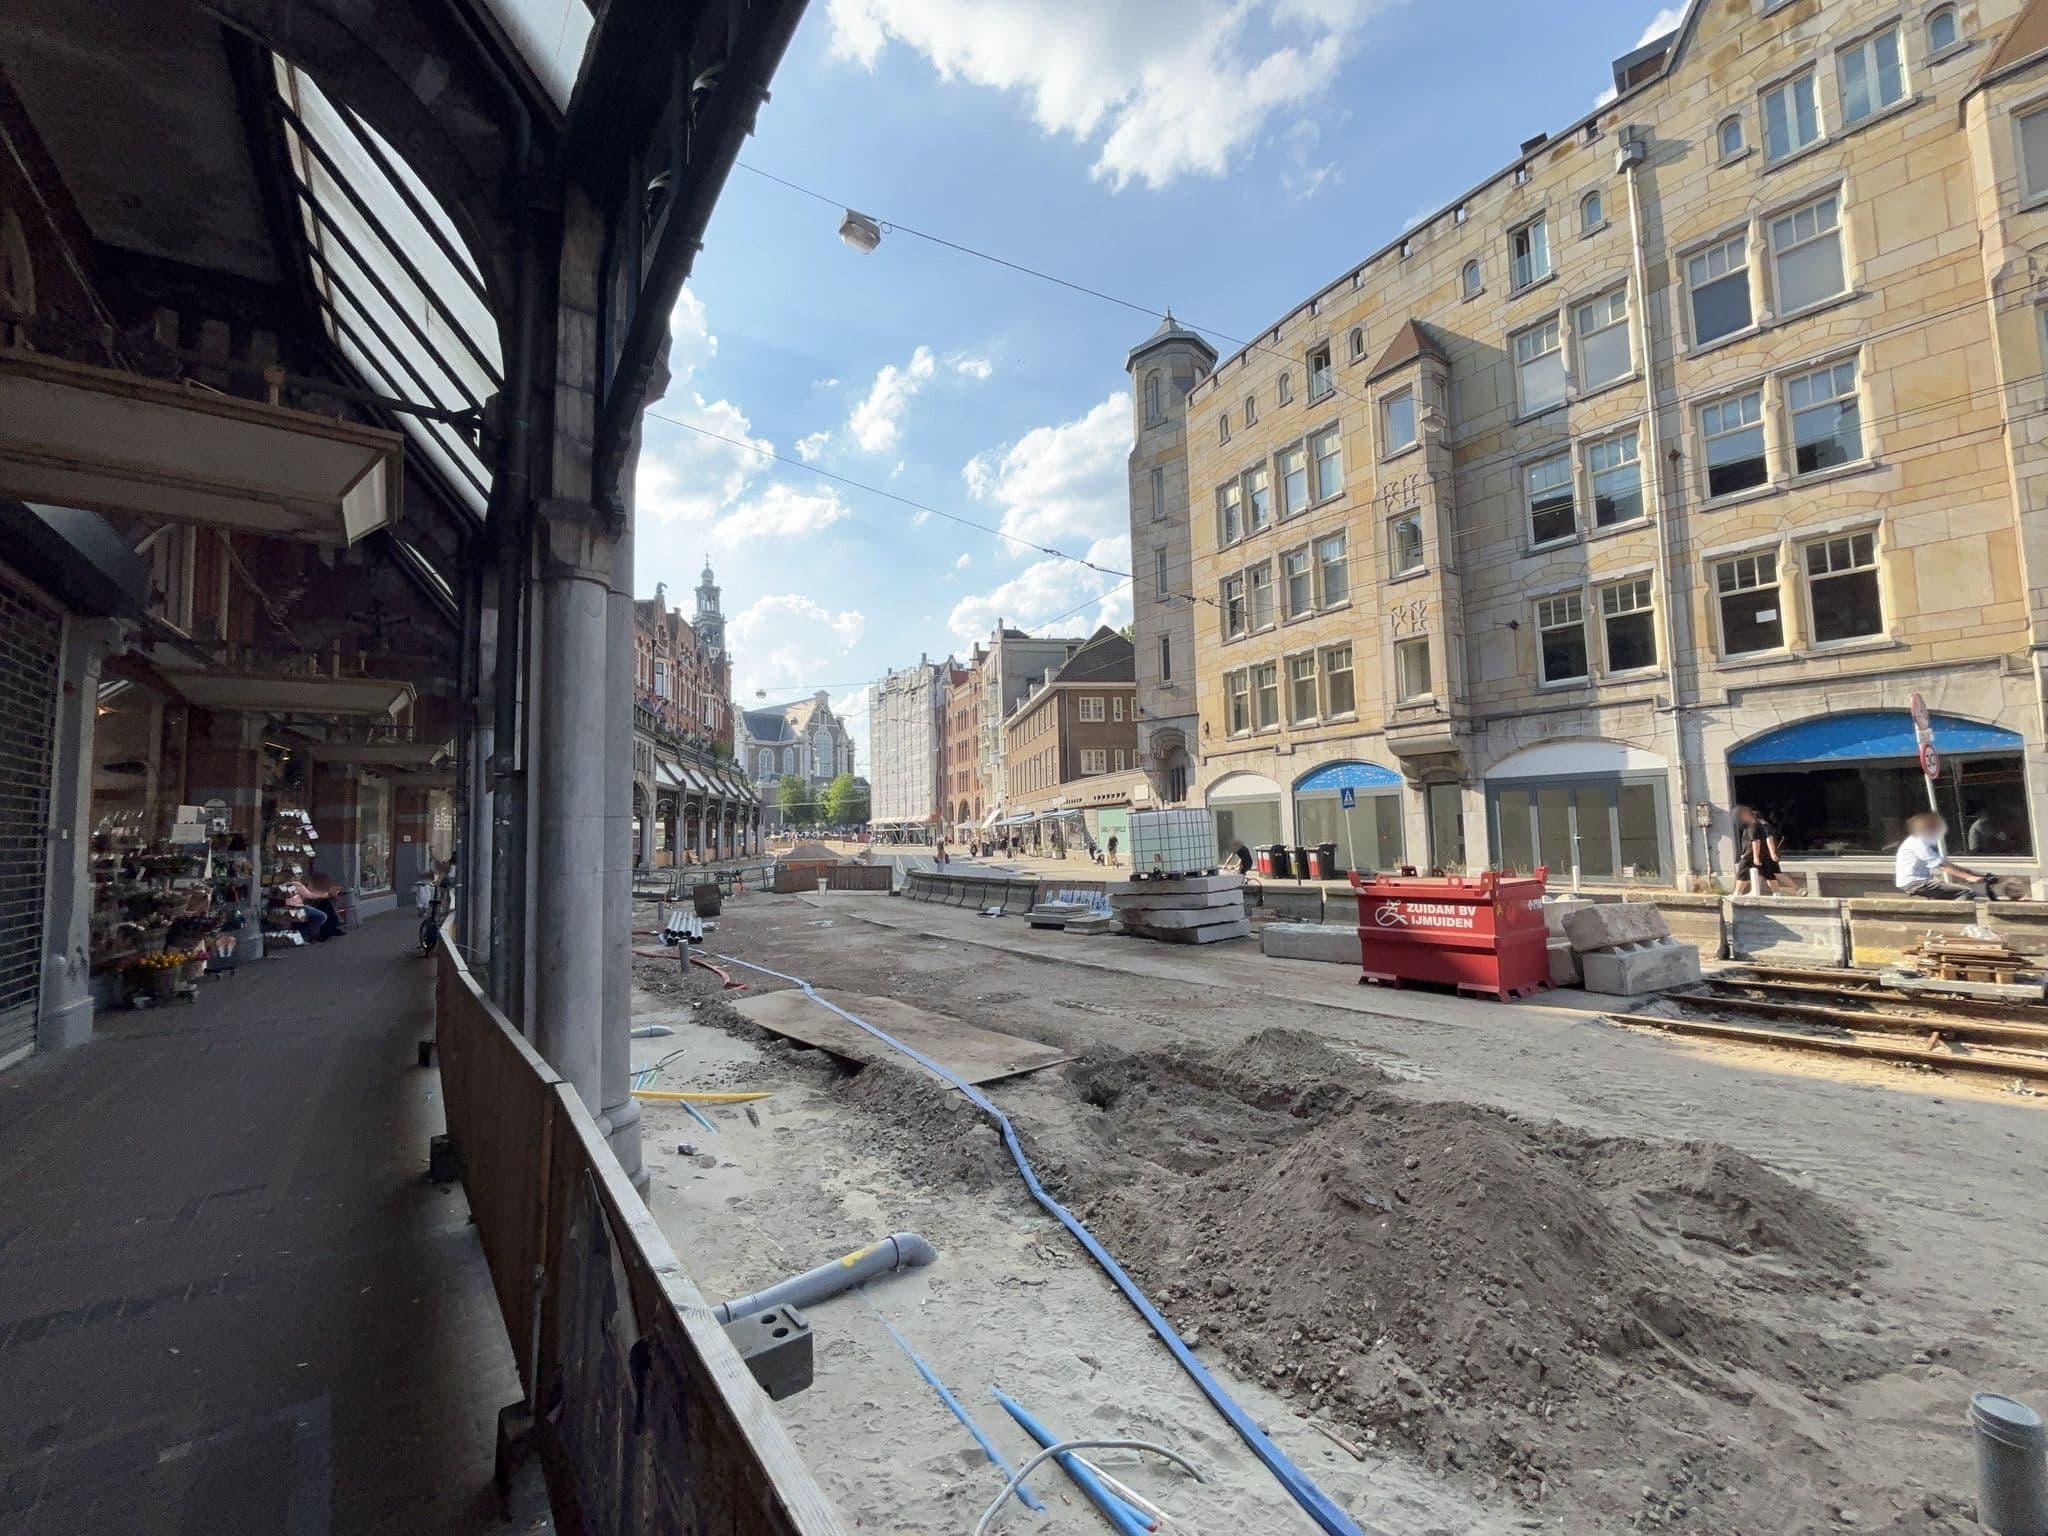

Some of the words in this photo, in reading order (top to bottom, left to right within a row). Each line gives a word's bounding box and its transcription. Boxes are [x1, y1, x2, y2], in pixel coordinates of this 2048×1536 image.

[1406, 903, 1455, 915] ZUIDAM
[1458, 905, 1476, 916] BV
[1411, 915, 1473, 928] IJMUIDEN
